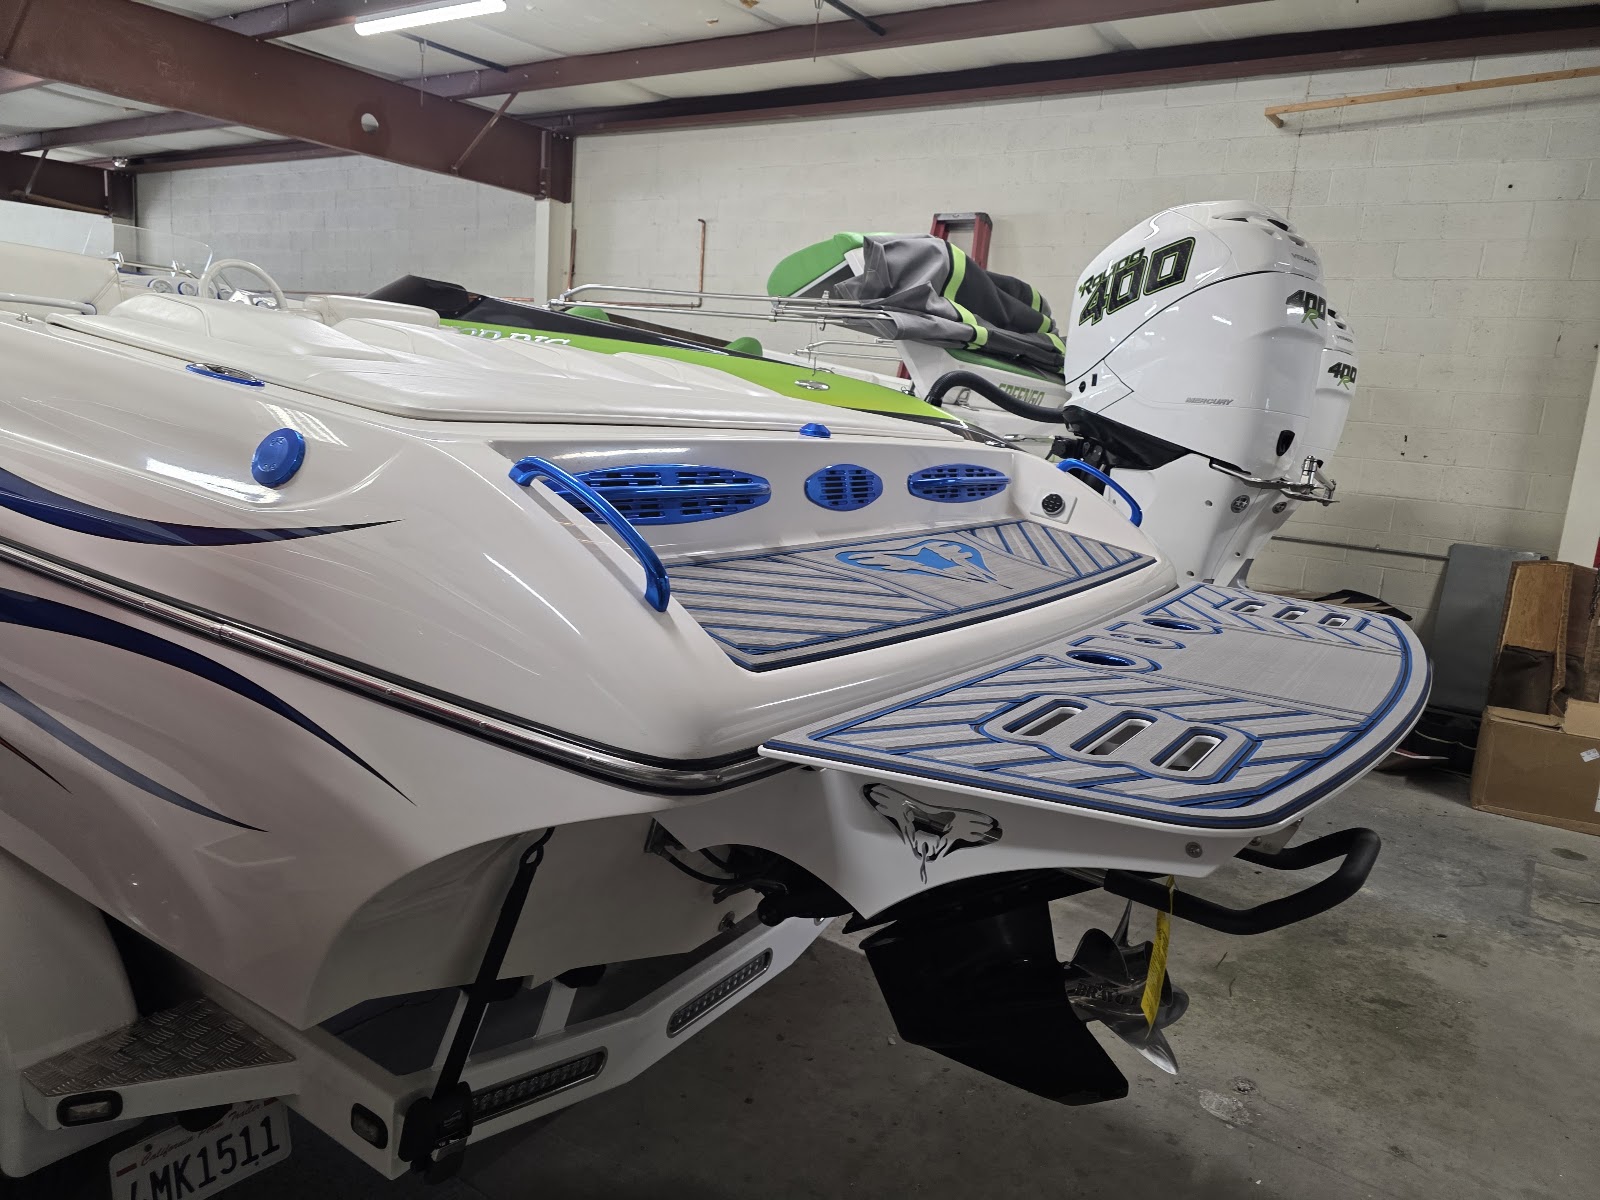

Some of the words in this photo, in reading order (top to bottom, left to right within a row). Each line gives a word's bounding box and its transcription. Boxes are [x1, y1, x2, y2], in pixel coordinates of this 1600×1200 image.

[1079, 236, 1196, 326] 400
[1327, 362, 1357, 384] 400
[1185, 397, 1234, 406] MERCURY
[140, 1135, 193, 1167] California
